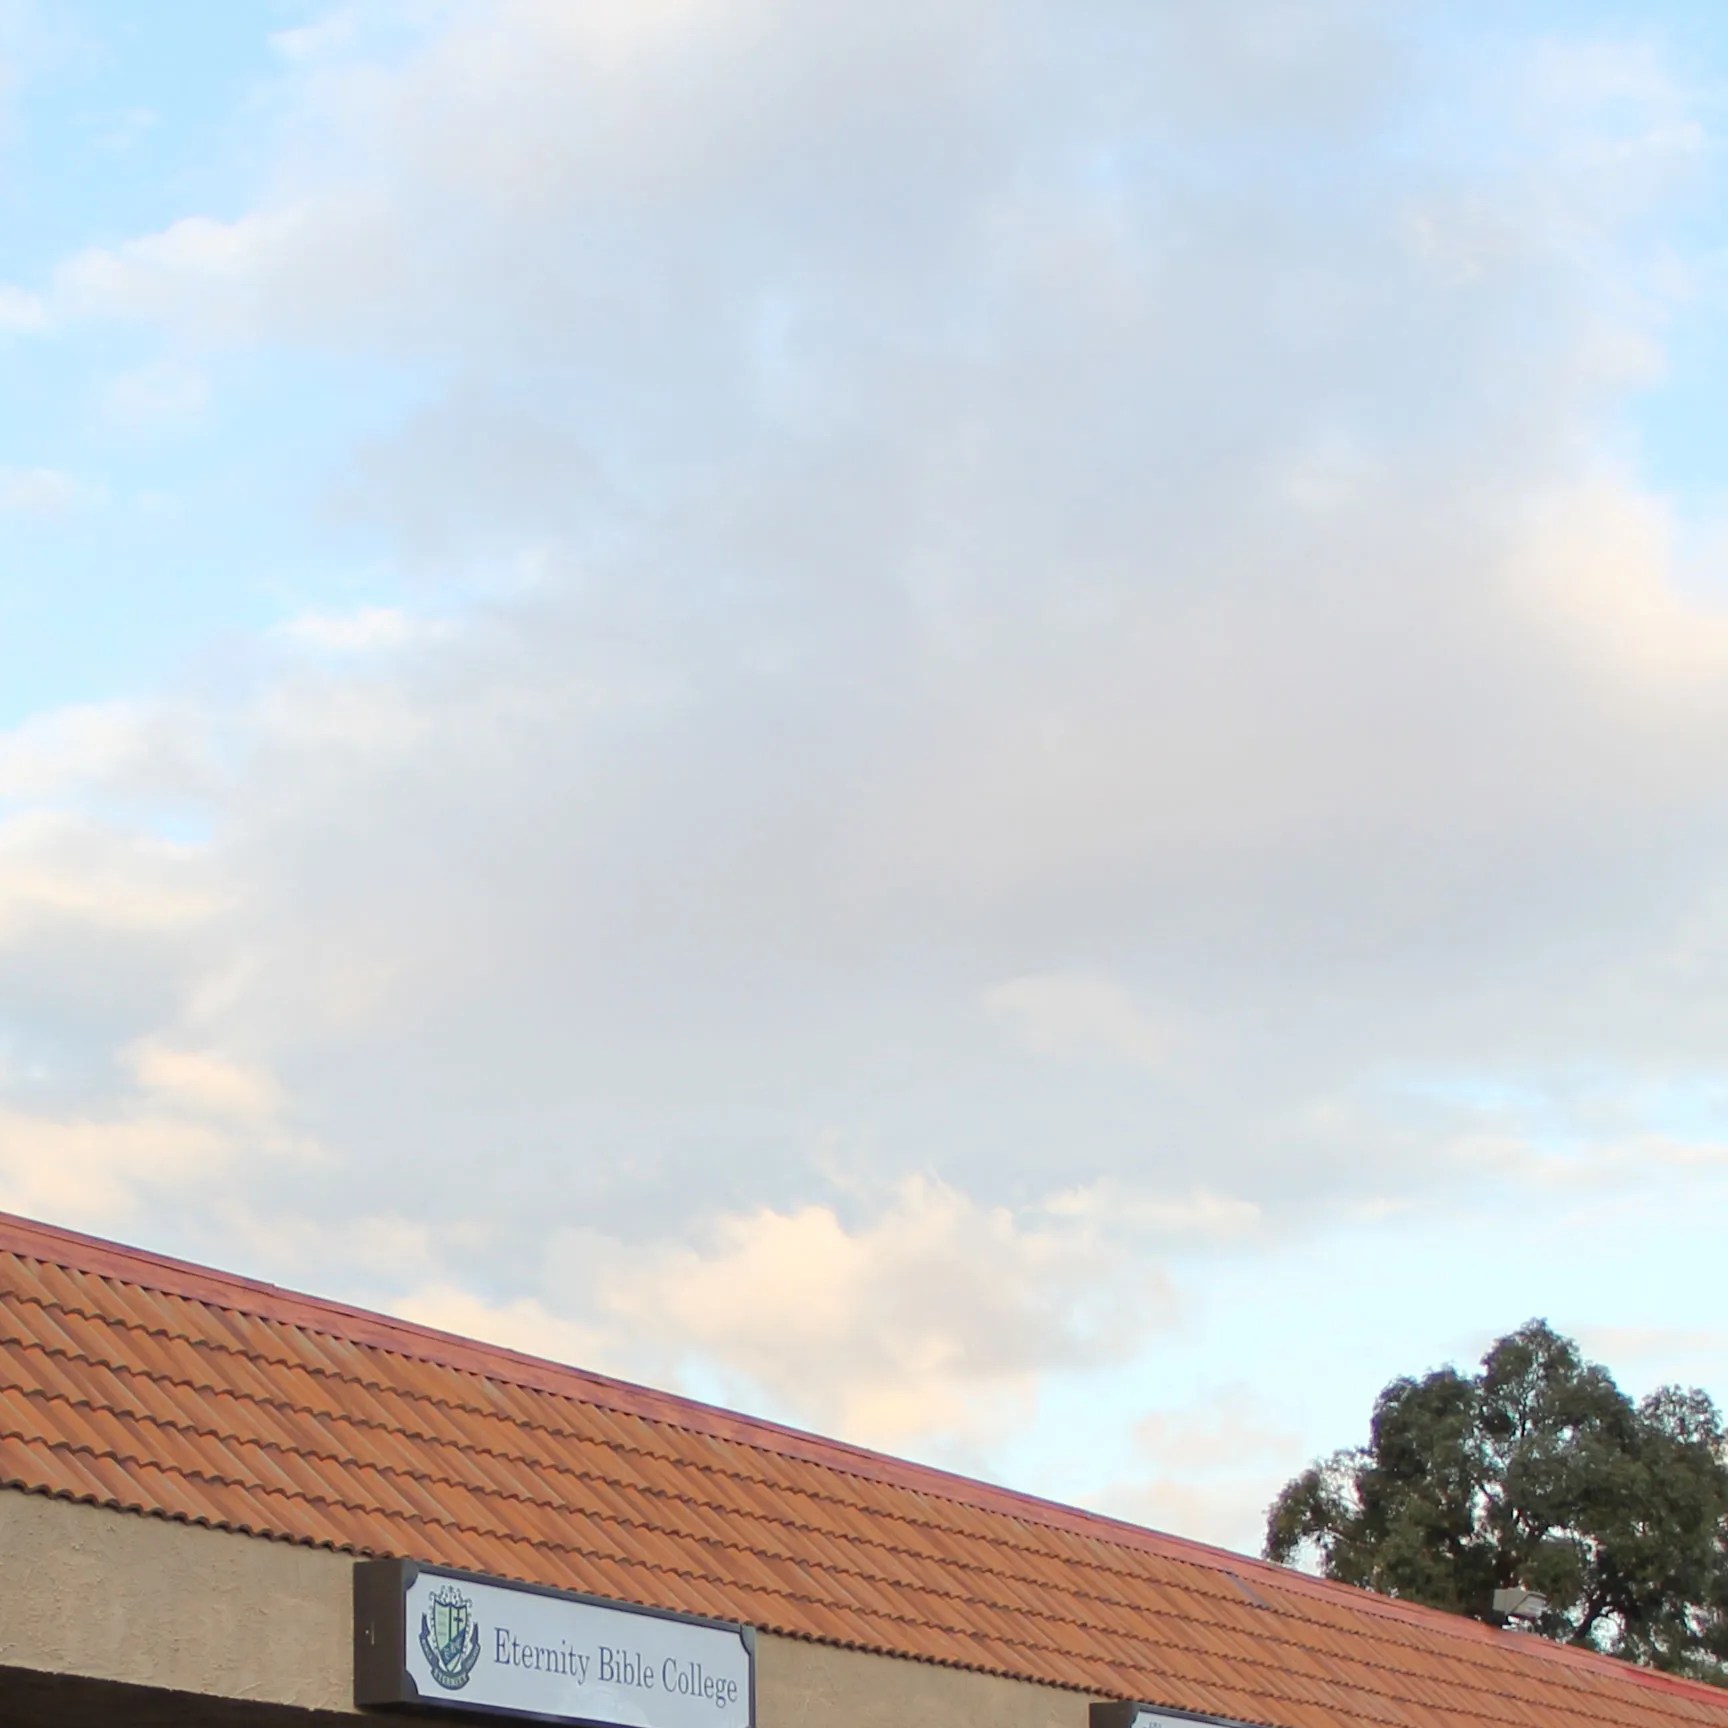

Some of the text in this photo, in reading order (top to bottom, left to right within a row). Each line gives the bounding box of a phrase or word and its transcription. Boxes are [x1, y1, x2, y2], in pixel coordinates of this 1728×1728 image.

[493, 1626, 590, 1686] Eternity
[598, 1646, 655, 1689] Bible
[662, 1657, 739, 1708] College
